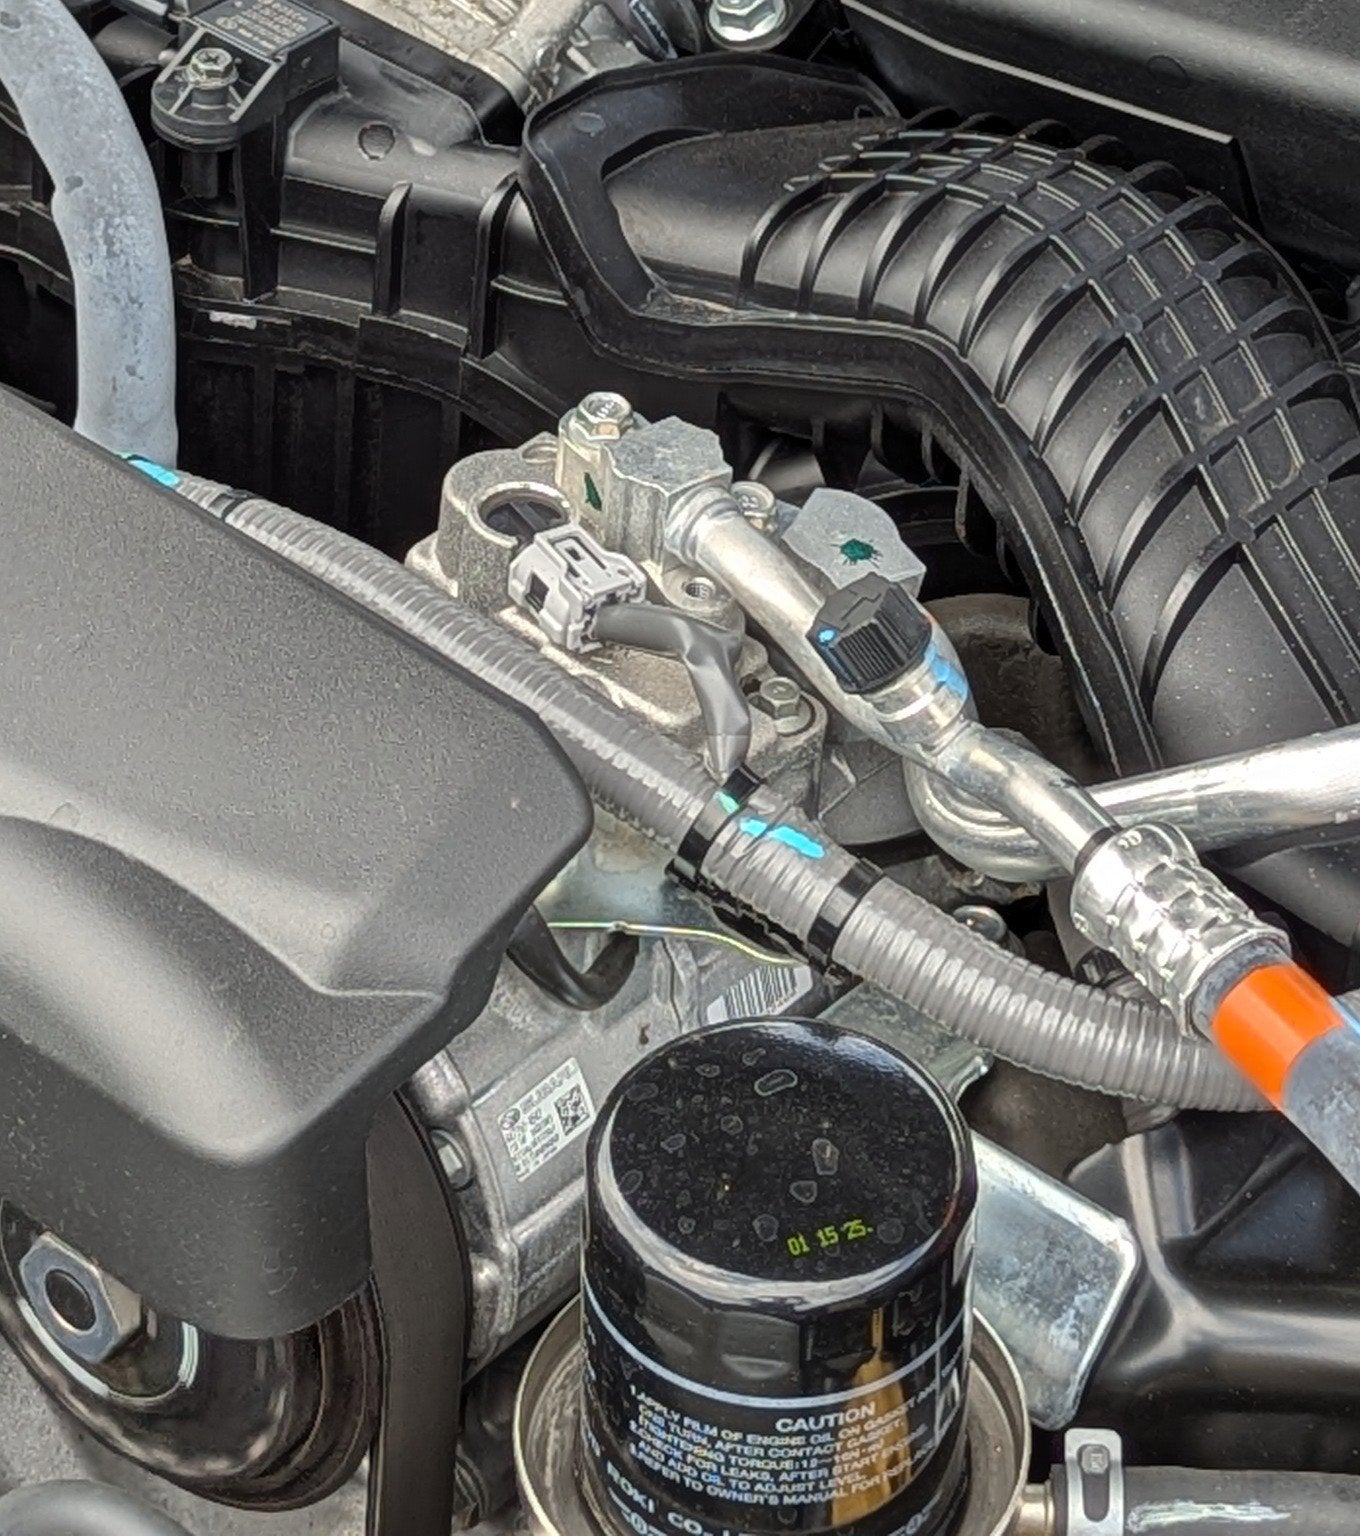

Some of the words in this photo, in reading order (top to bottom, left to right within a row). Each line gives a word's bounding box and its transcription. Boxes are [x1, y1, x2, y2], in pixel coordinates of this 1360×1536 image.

[786, 1232, 810, 1256] 01
[816, 1224, 839, 1249] 15
[775, 1400, 876, 1433] CAUTION
[715, 1440, 766, 1458] AFTER
[768, 1441, 845, 1459] CONTACT
[809, 1431, 836, 1446] OIL
[838, 1423, 862, 1441] ON
[667, 1458, 699, 1479] ADD
[728, 1477, 752, 1492] TO
[754, 1480, 817, 1495] ADJUST
[685, 1452, 719, 1473] FOR
[778, 1467, 830, 1482] AFTER
[682, 1475, 704, 1493] TO
[705, 1484, 780, 1506] OWNER'S
[782, 1485, 850, 1506] MANUAL
